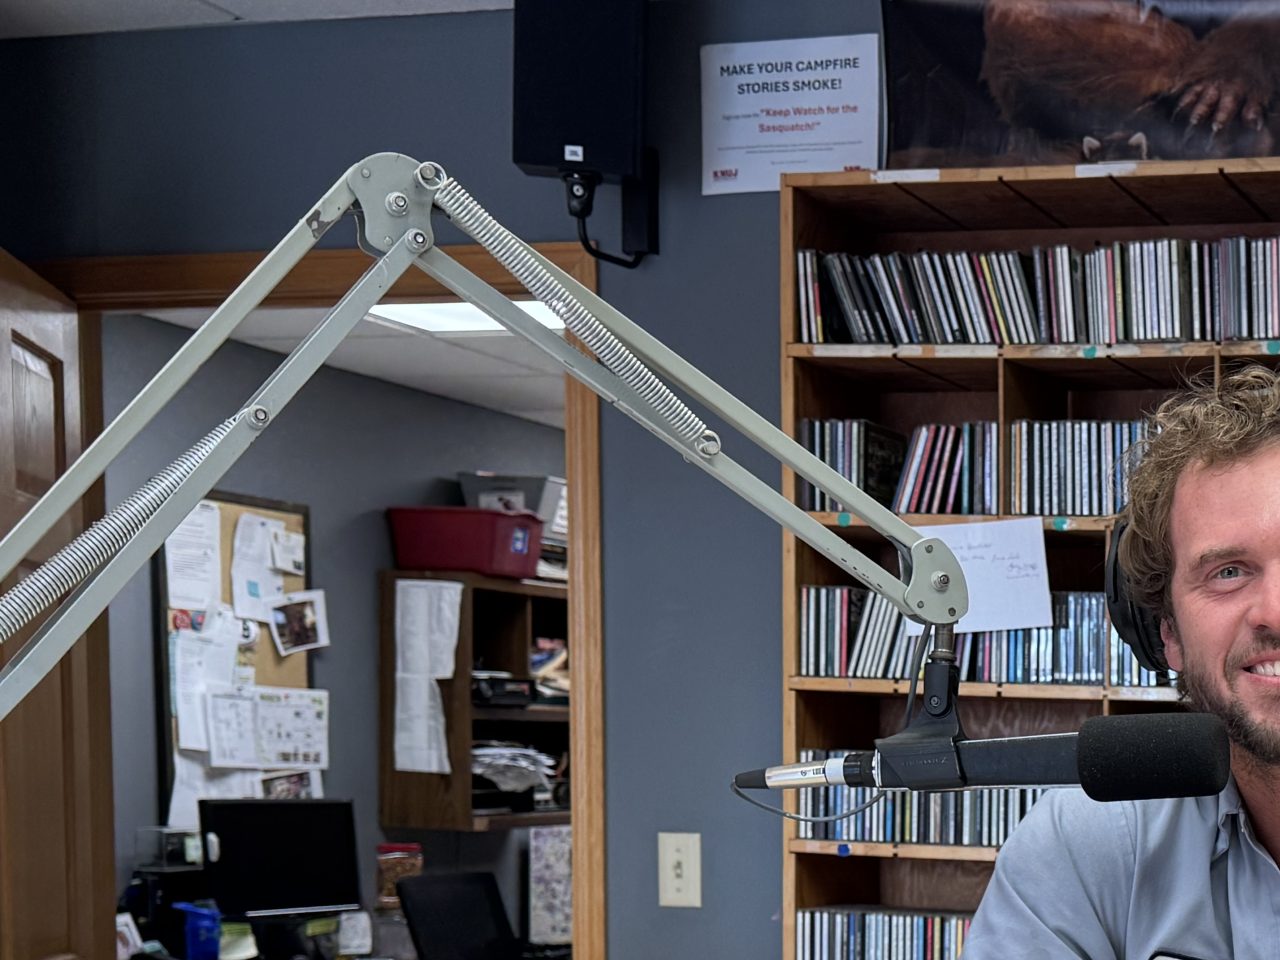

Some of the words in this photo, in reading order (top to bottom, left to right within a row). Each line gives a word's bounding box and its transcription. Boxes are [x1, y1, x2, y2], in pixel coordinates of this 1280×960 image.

[720, 64, 754, 76] MAKE
[756, 61, 793, 74] YOUR
[795, 57, 860, 72] CAMPFIRE
[737, 81, 790, 95] STORIES
[793, 78, 842, 91] SMOKE!
[792, 105, 824, 116] Watch
[826, 105, 840, 114] for
[841, 104, 858, 113] the
